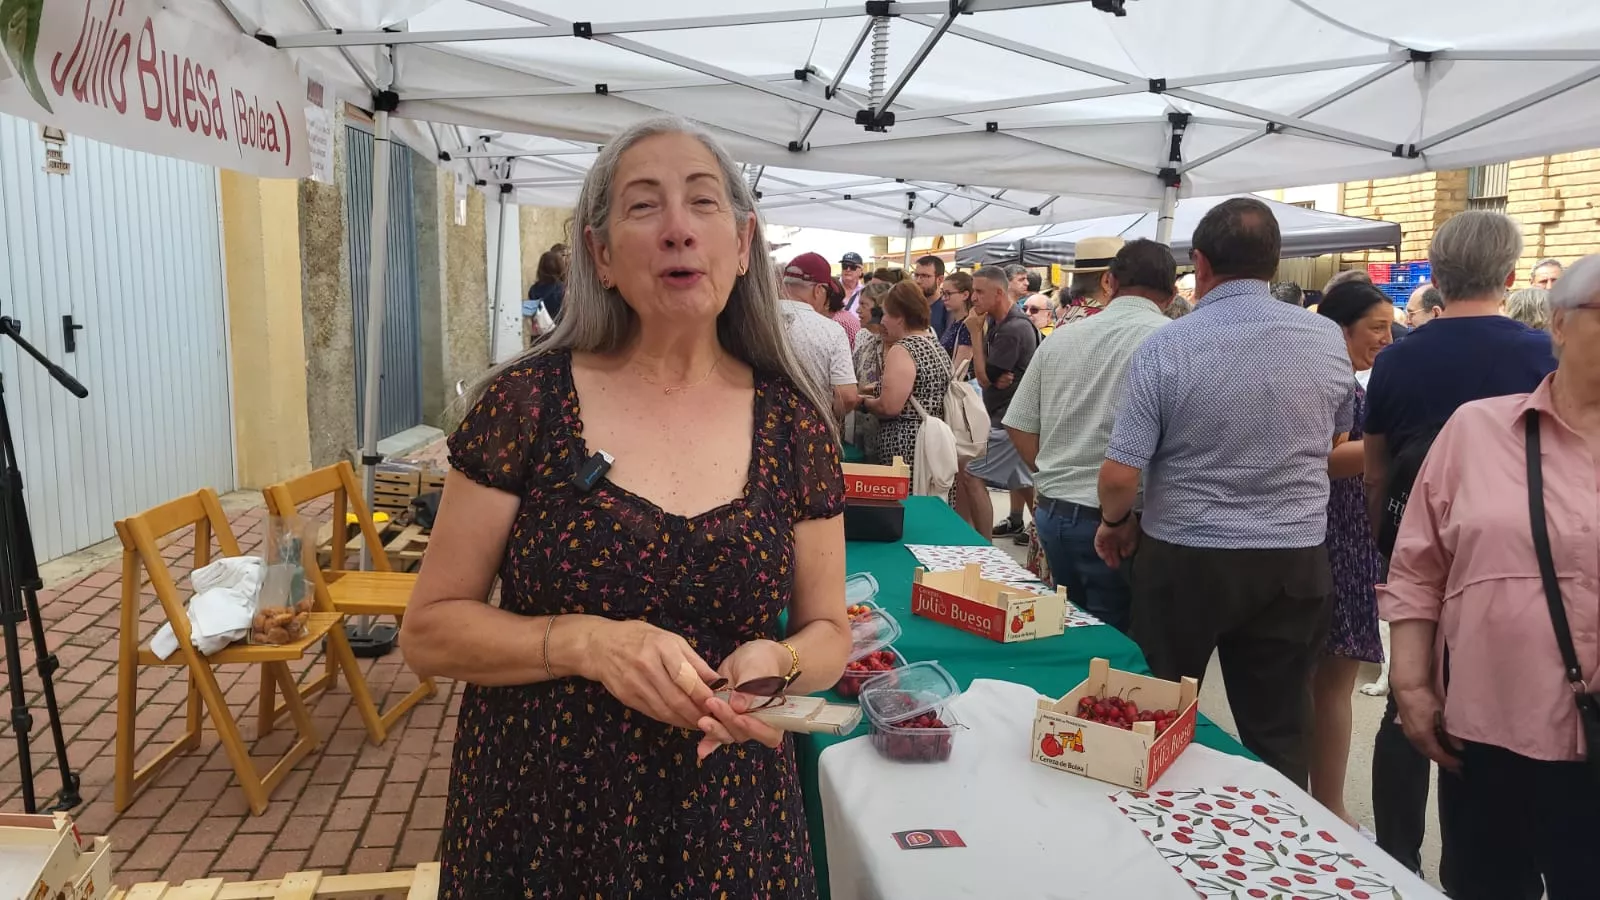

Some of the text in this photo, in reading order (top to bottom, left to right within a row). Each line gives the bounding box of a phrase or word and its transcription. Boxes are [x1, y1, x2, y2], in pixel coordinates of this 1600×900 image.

[50, 0, 291, 166] Julio Buesa (Bolea)
[855, 481, 895, 494] Buesa
[916, 593, 991, 630] Julio Buesa
[1171, 723, 1192, 755] Buesa
